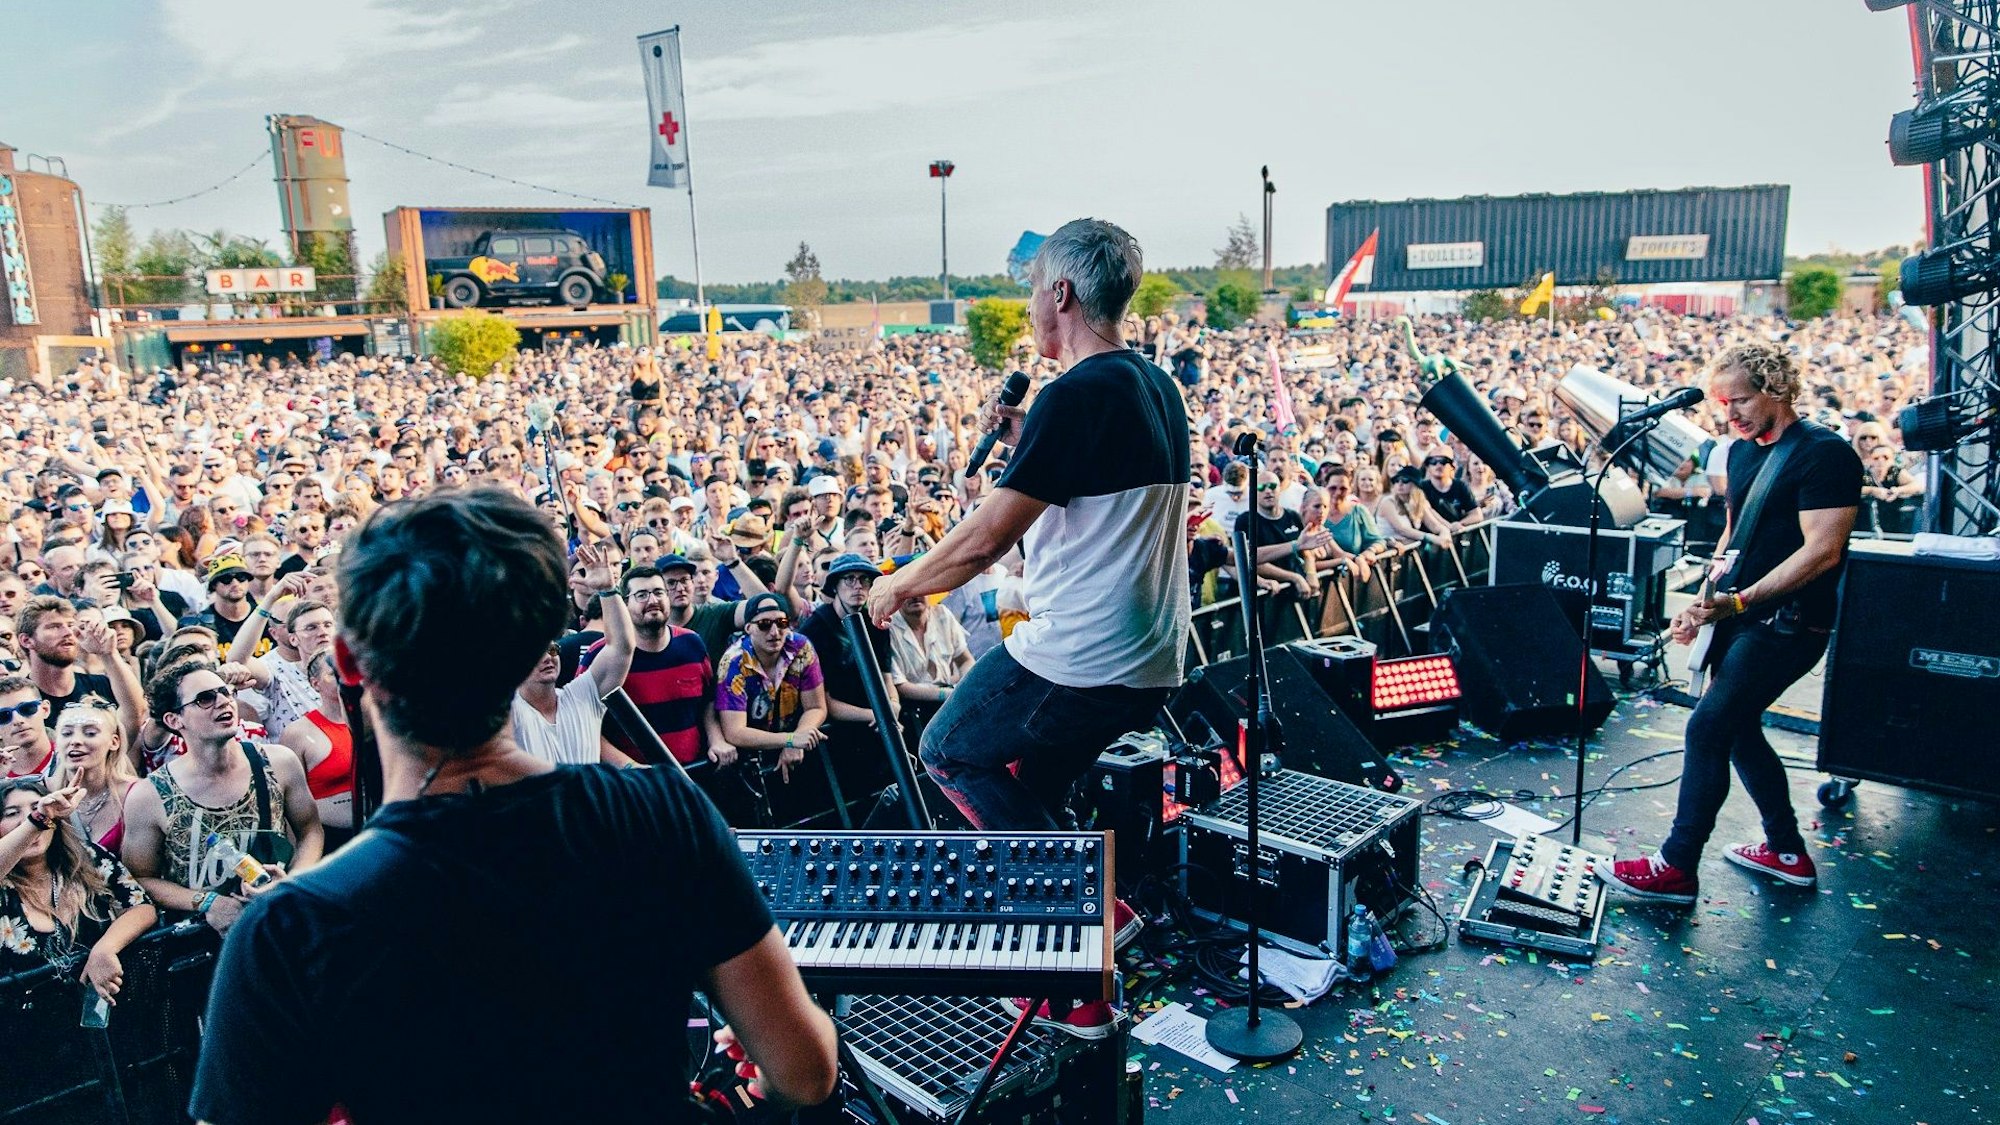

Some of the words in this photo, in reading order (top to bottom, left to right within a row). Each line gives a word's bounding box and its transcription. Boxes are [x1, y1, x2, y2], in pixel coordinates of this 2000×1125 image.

[1641, 241, 1696, 254] TOILETS
[1420, 248, 1473, 262] TOILETS
[220, 273, 304, 288] BAR
[1918, 651, 1993, 670] MESA
